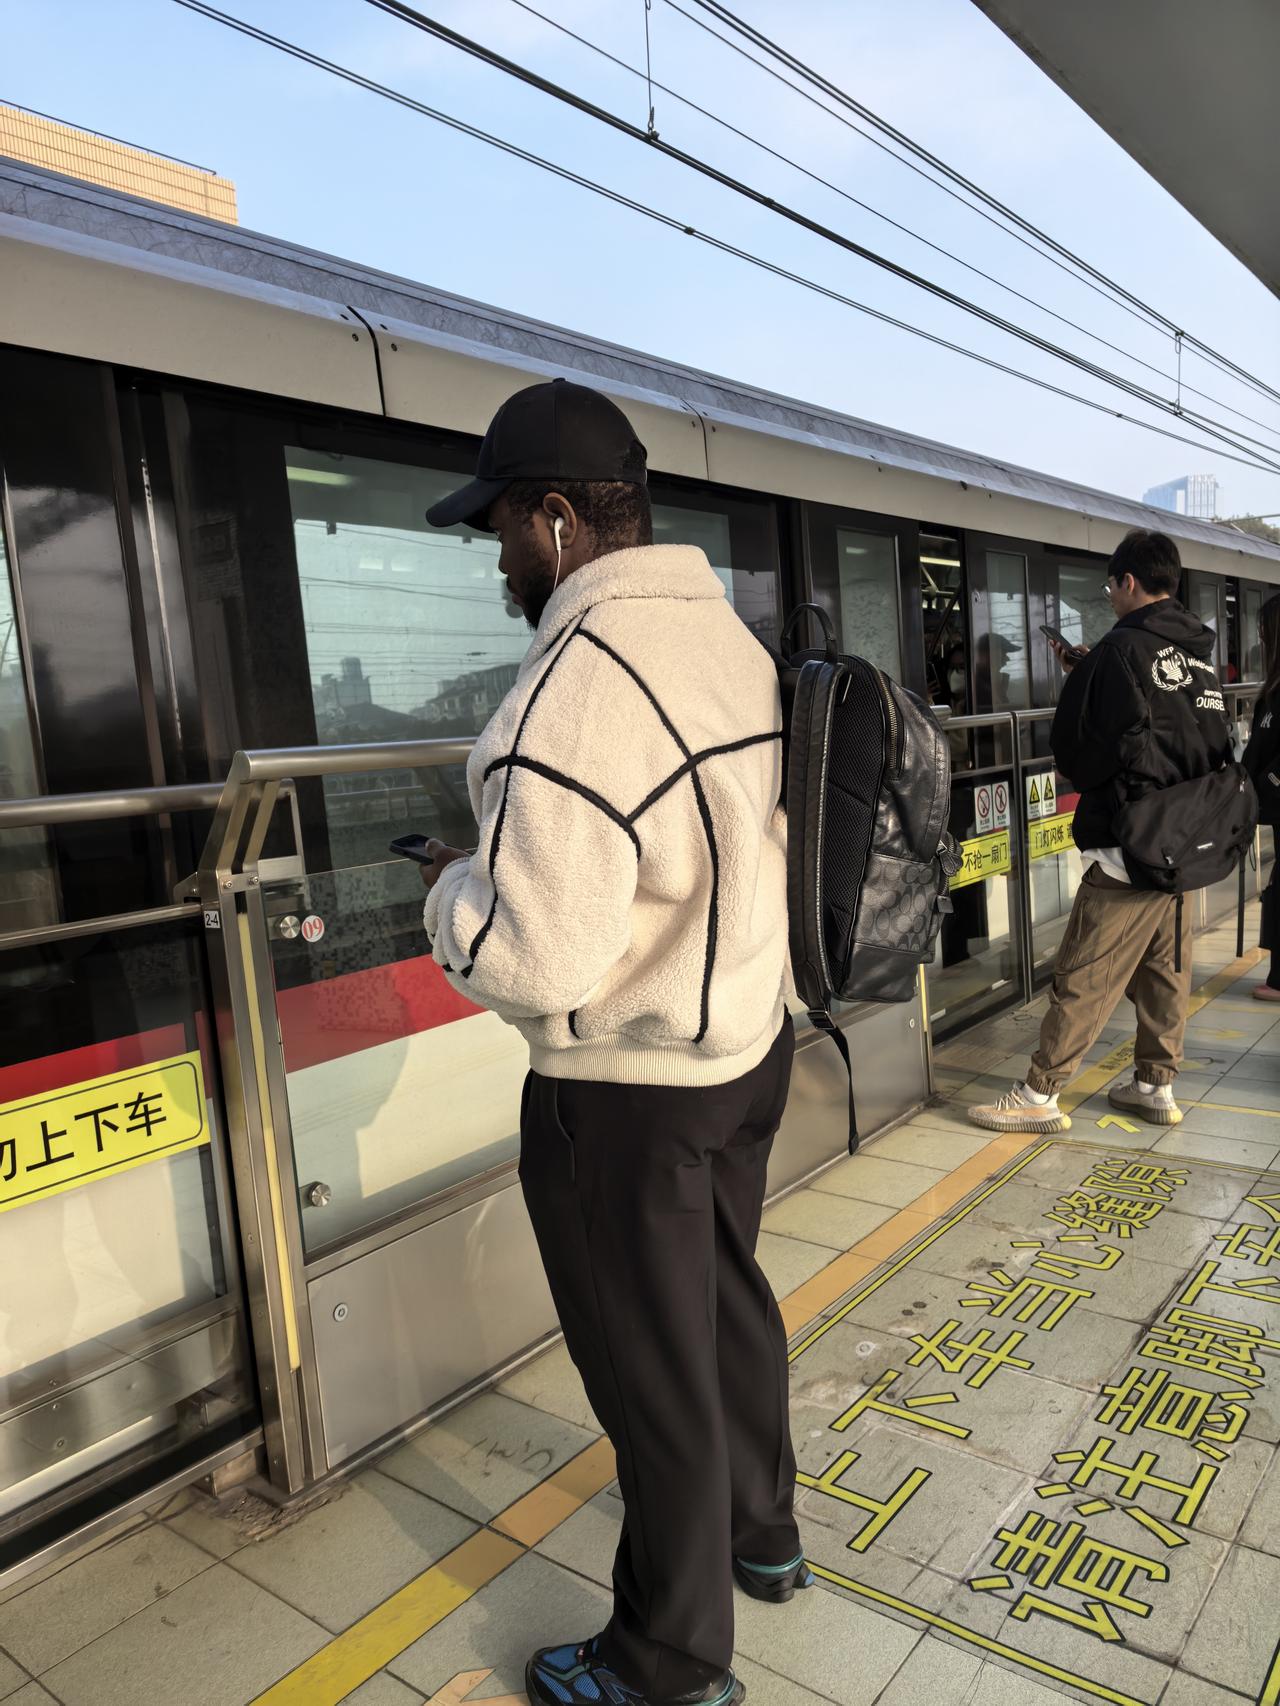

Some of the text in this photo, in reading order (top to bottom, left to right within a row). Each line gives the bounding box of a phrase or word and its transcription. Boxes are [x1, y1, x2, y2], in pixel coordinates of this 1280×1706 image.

[1157, 646, 1175, 658] WFP
[1035, 825, 1064, 849] 门灯闪烁
[964, 842, 1008, 872] 不抢一扇门
[205, 913, 219, 927] 2-4
[303, 917, 323, 939] 09
[797, 1159, 1192, 1554] 上下车当心缝隙
